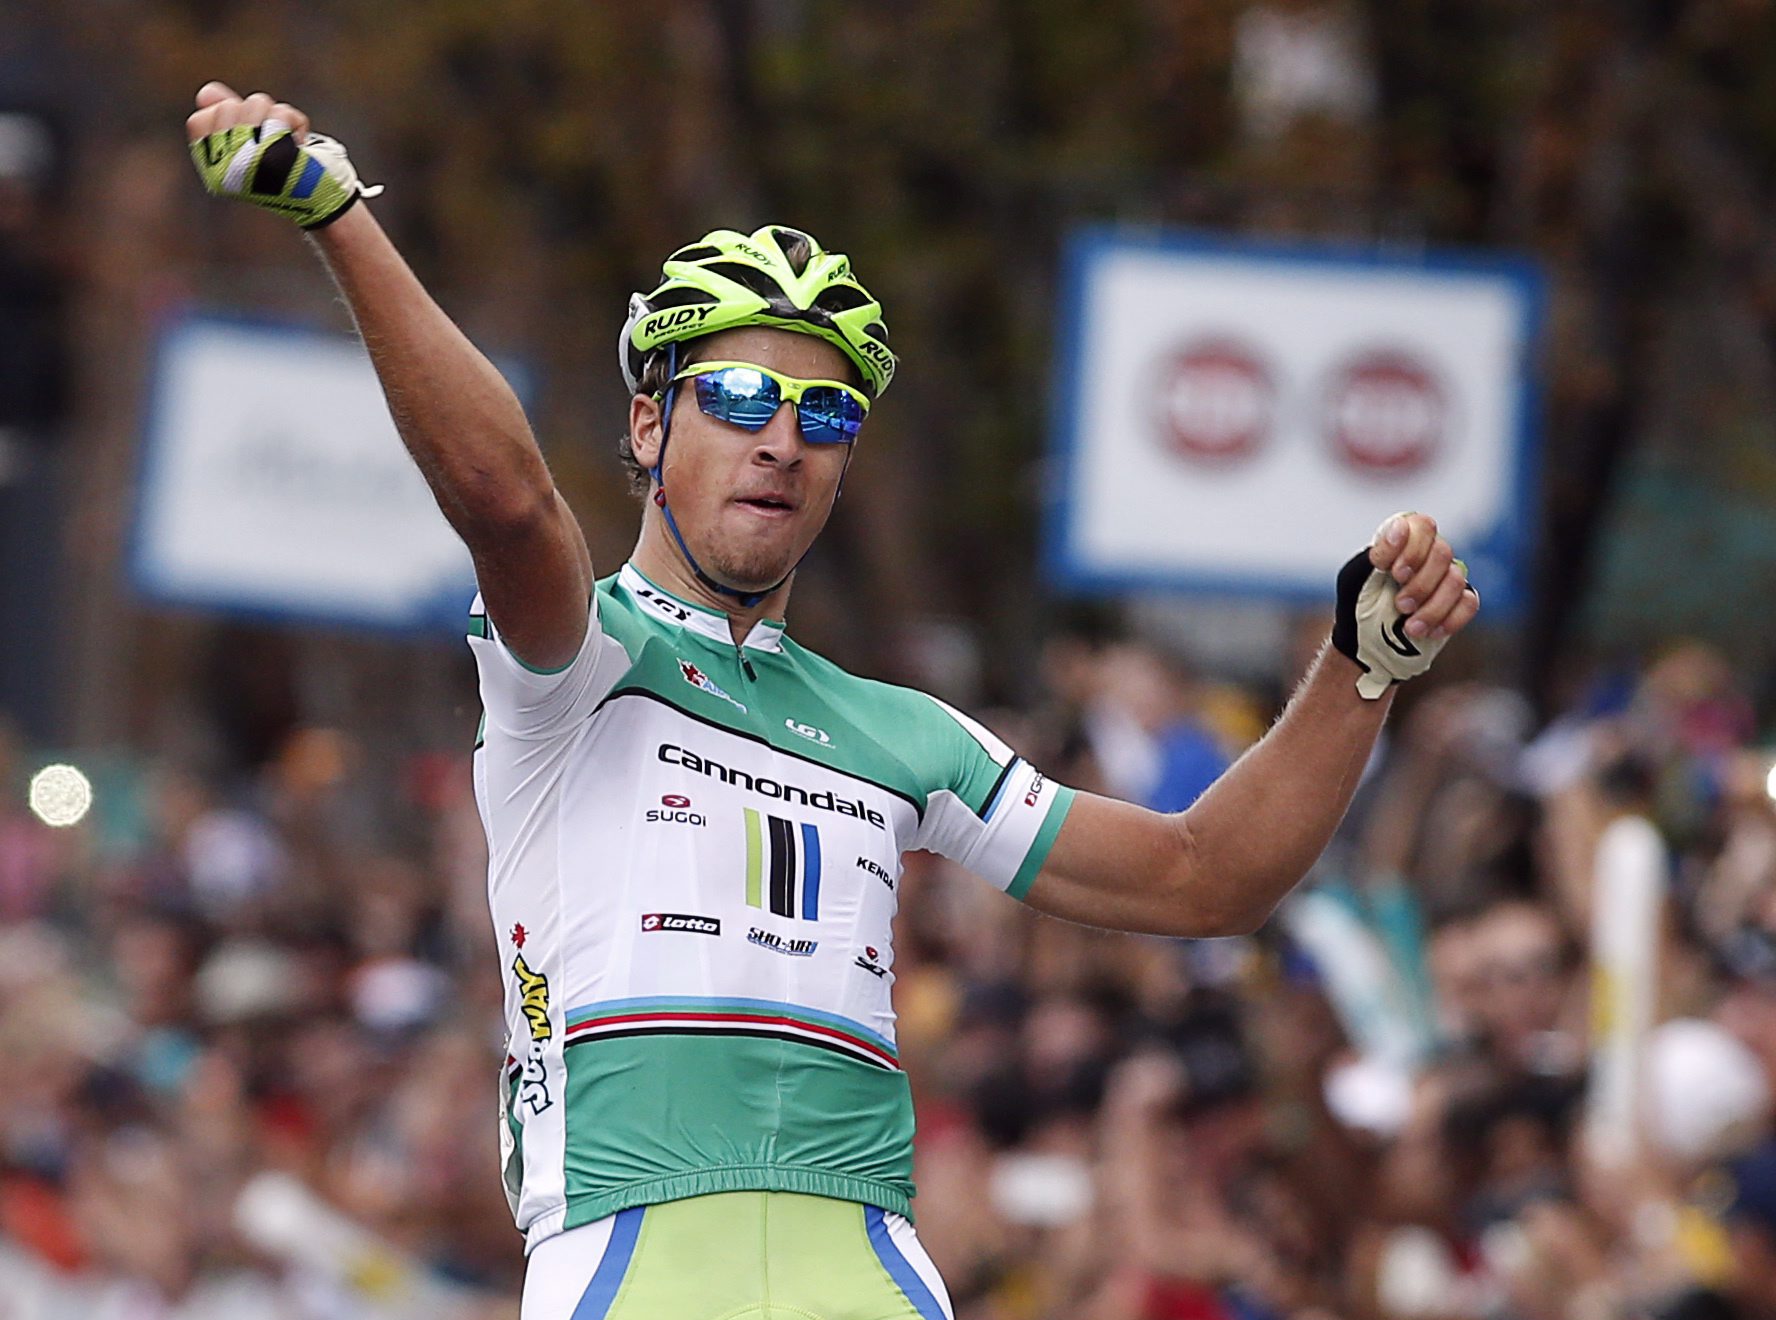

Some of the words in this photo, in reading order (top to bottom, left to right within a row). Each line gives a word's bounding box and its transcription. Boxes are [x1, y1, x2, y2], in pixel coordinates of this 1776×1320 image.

[735, 243, 777, 267] RUDY
[645, 306, 717, 337] RUDY
[658, 743, 886, 830] cannondale
[856, 856, 894, 891] KENDA
